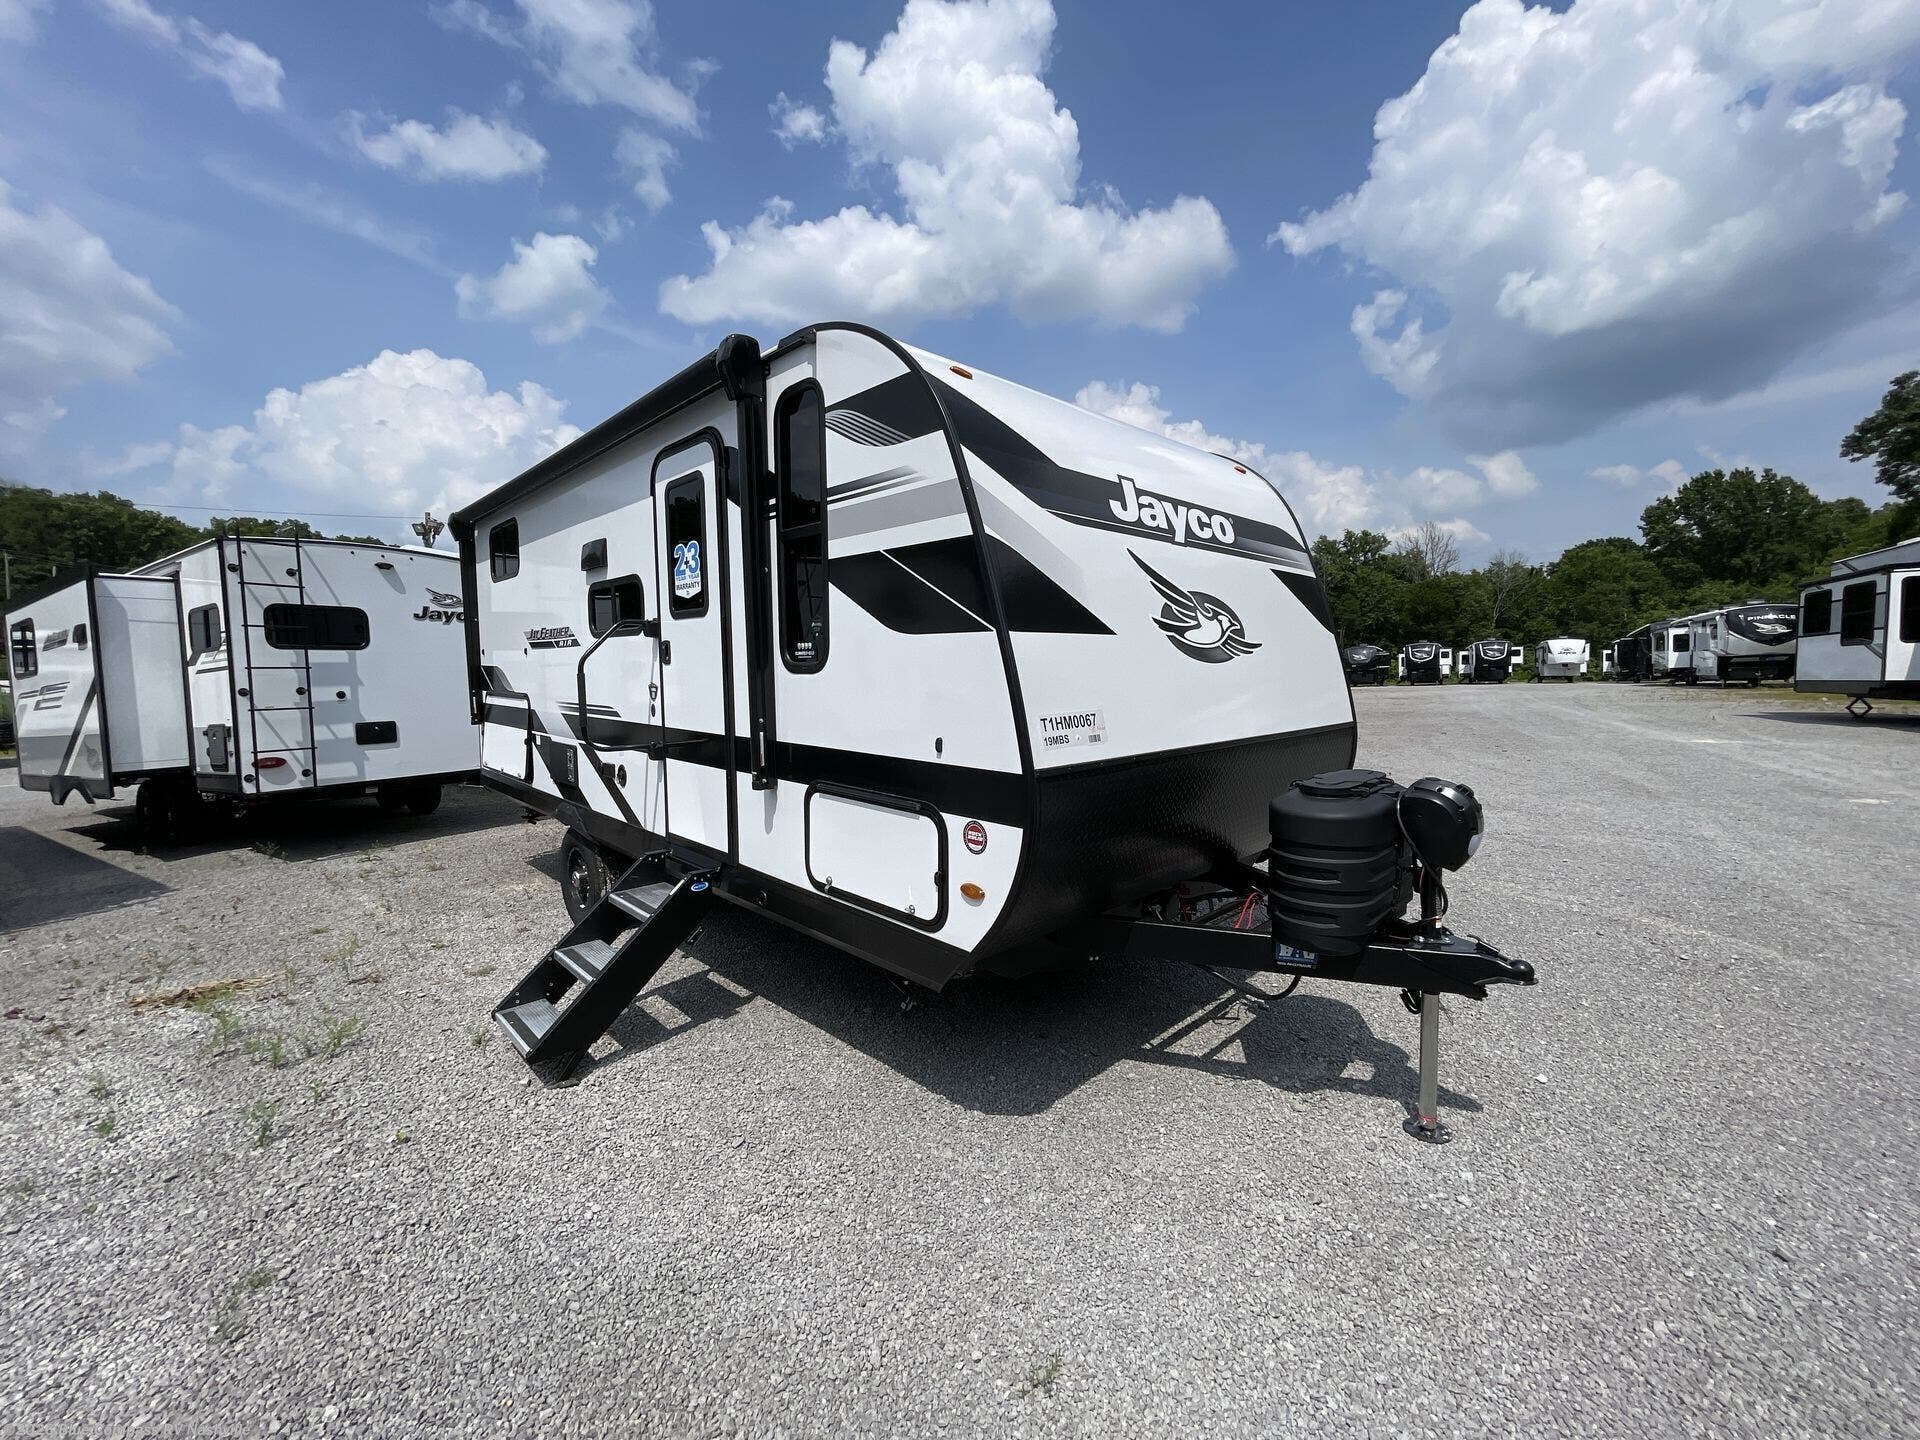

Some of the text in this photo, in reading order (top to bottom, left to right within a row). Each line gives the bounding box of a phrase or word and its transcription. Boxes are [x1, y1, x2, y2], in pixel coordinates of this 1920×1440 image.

[1108, 478, 1235, 544] Jayco
[676, 581, 700, 591] WARRANTY
[413, 605, 465, 625] Jayc
[1039, 713, 1096, 732] T1HM0067
[1044, 734, 1070, 746] 19MBS
